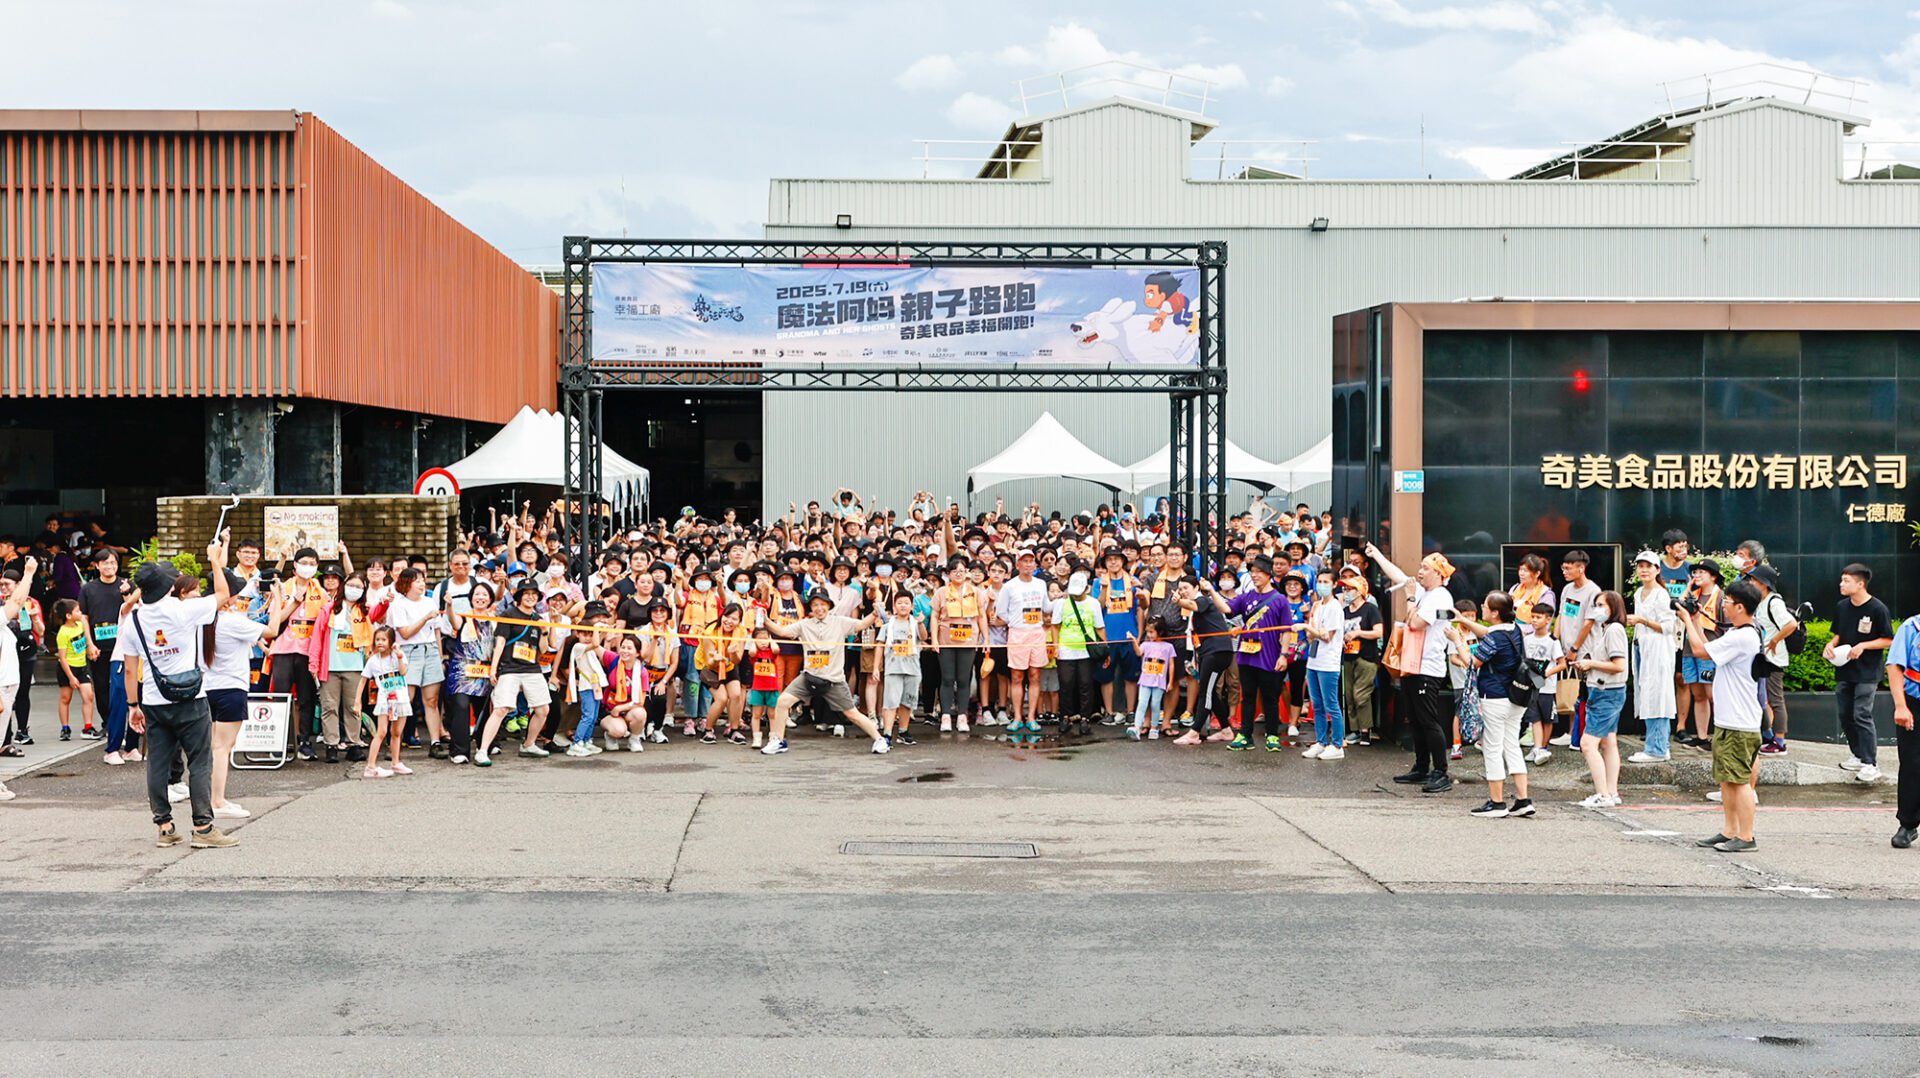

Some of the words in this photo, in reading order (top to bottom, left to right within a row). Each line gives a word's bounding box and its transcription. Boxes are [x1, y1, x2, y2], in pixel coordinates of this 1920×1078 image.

[900, 282, 1036, 323] 親子路跑
[822, 326, 841, 337] AND
[842, 325, 861, 334] HER
[862, 322, 896, 332] GHOSTS
[900, 315, 1035, 341] 奇美食品幸福開跑!
[1540, 453, 1908, 490] 奇美食品股份有限公司
[284, 511, 297, 521] No
[1846, 503, 1906, 523] 仁德廠
